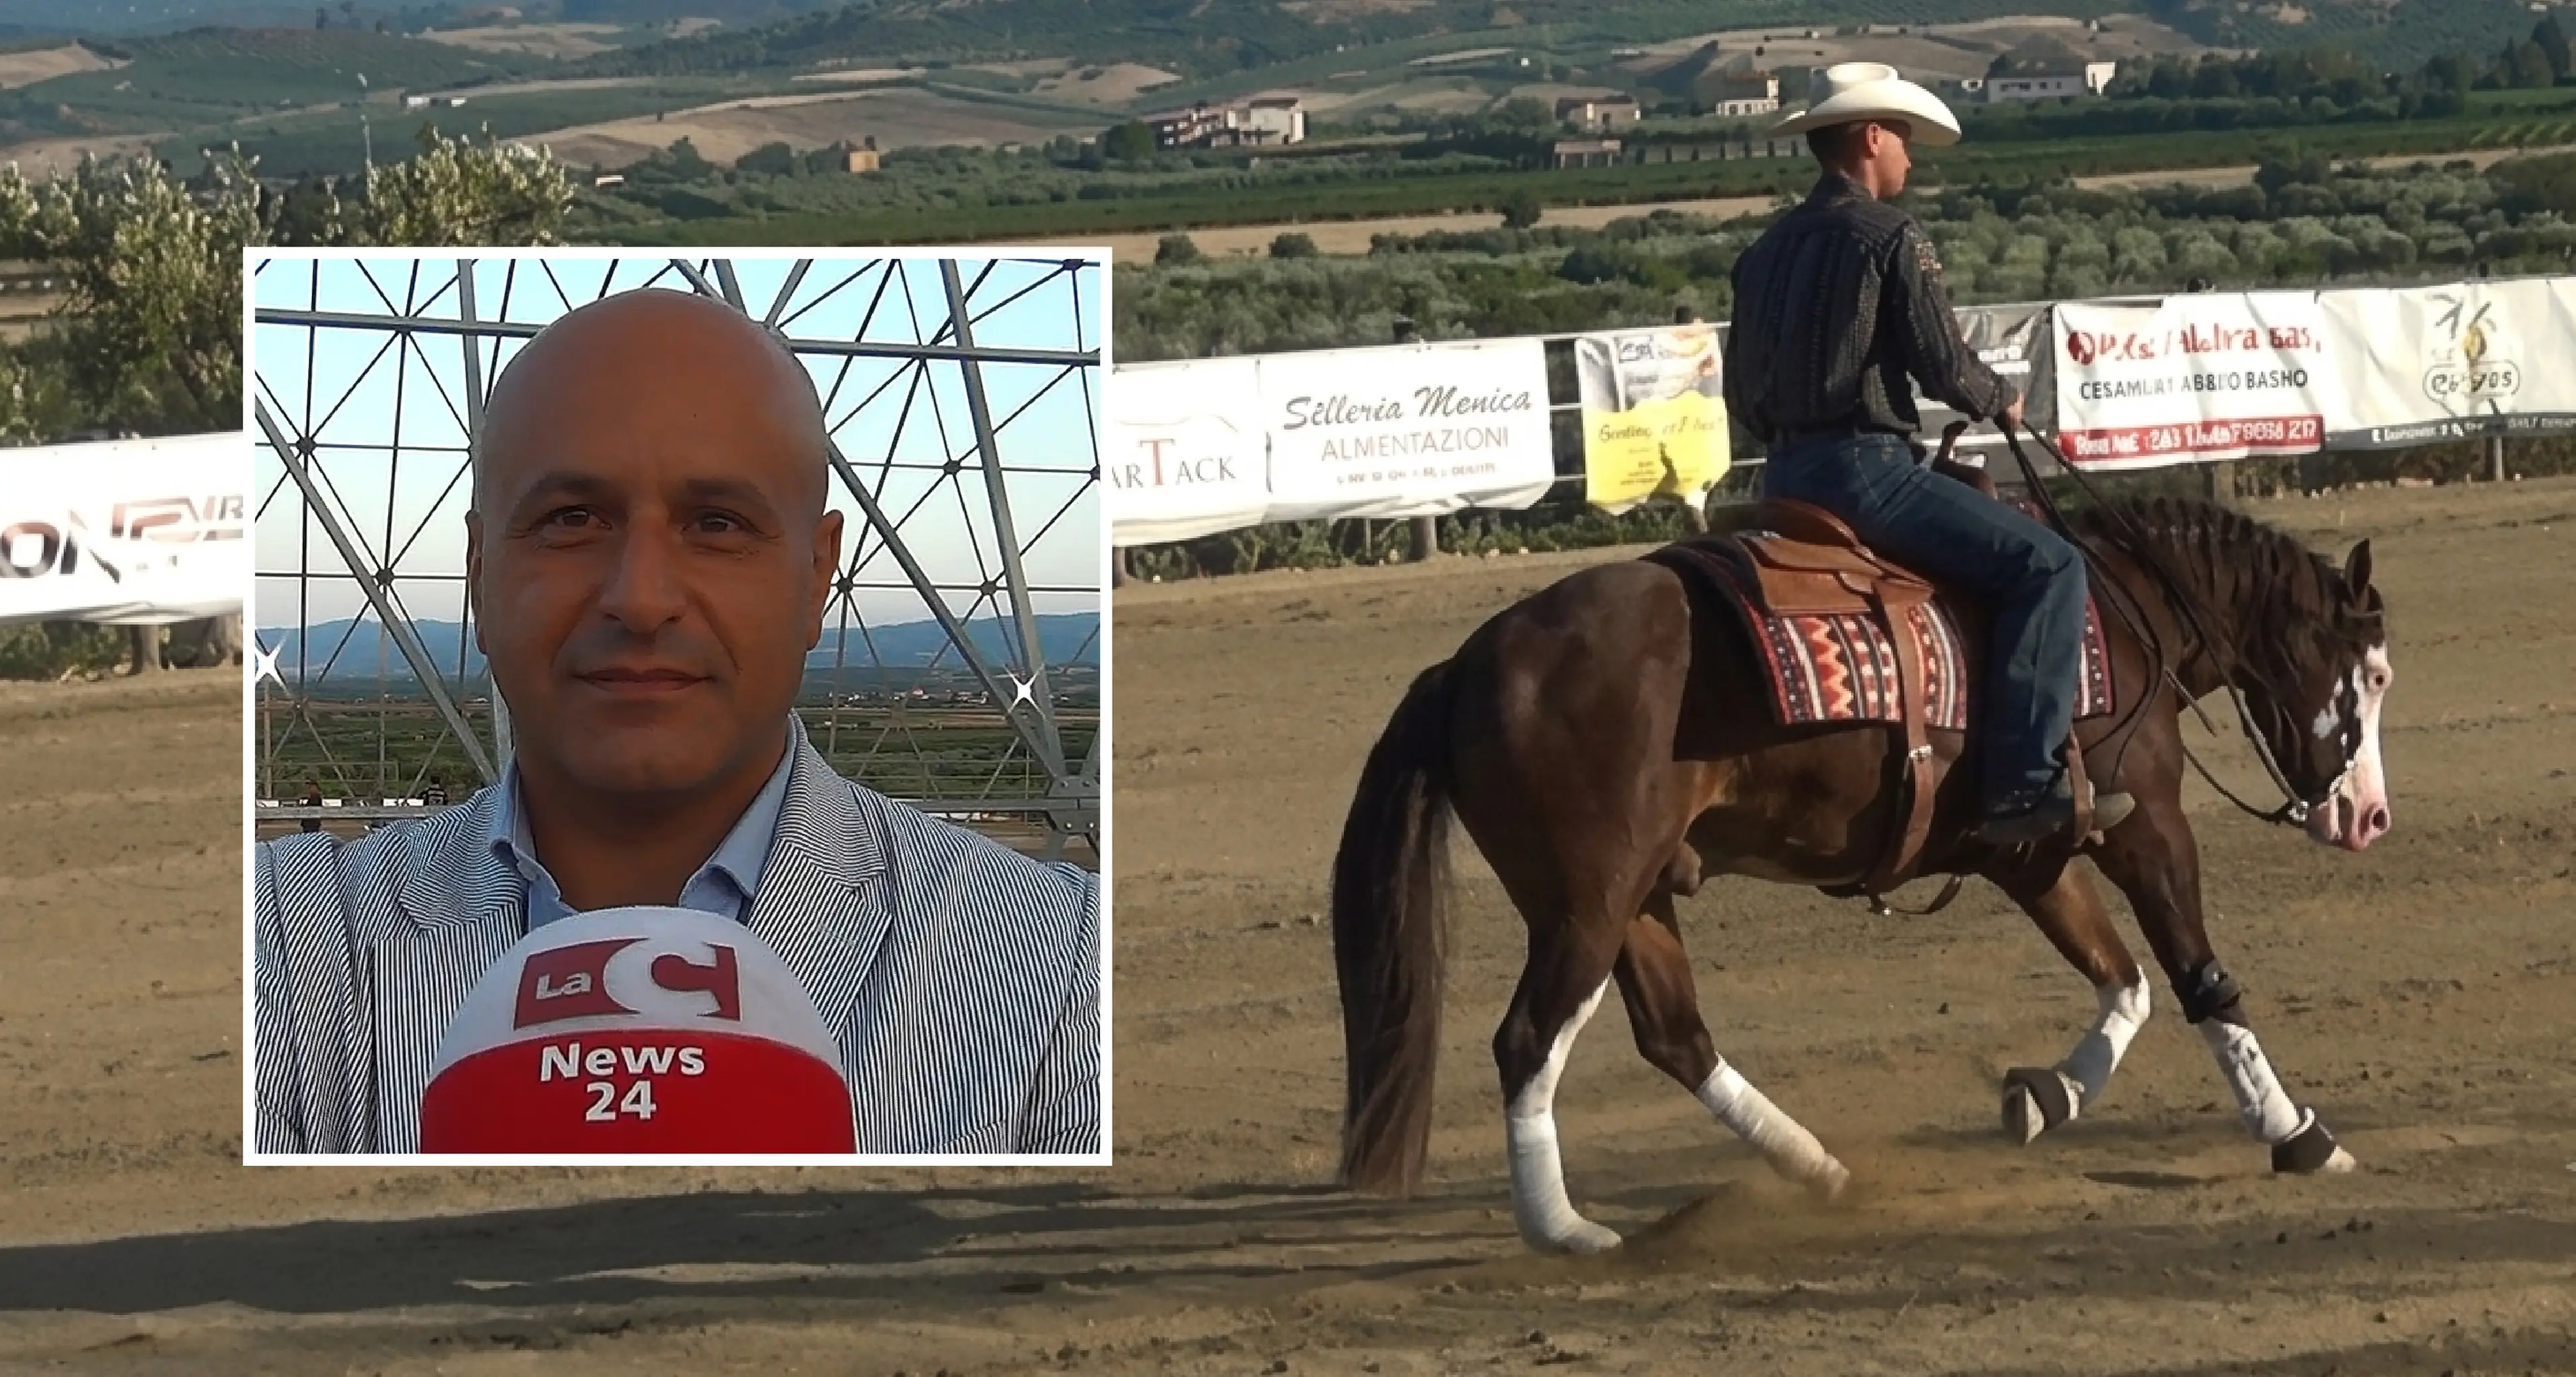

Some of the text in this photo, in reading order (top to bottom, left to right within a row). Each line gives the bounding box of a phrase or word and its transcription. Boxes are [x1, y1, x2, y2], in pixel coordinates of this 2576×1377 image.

[535, 969, 592, 1001] La
[539, 1041, 706, 1083] News
[584, 1080, 657, 1122] 24
